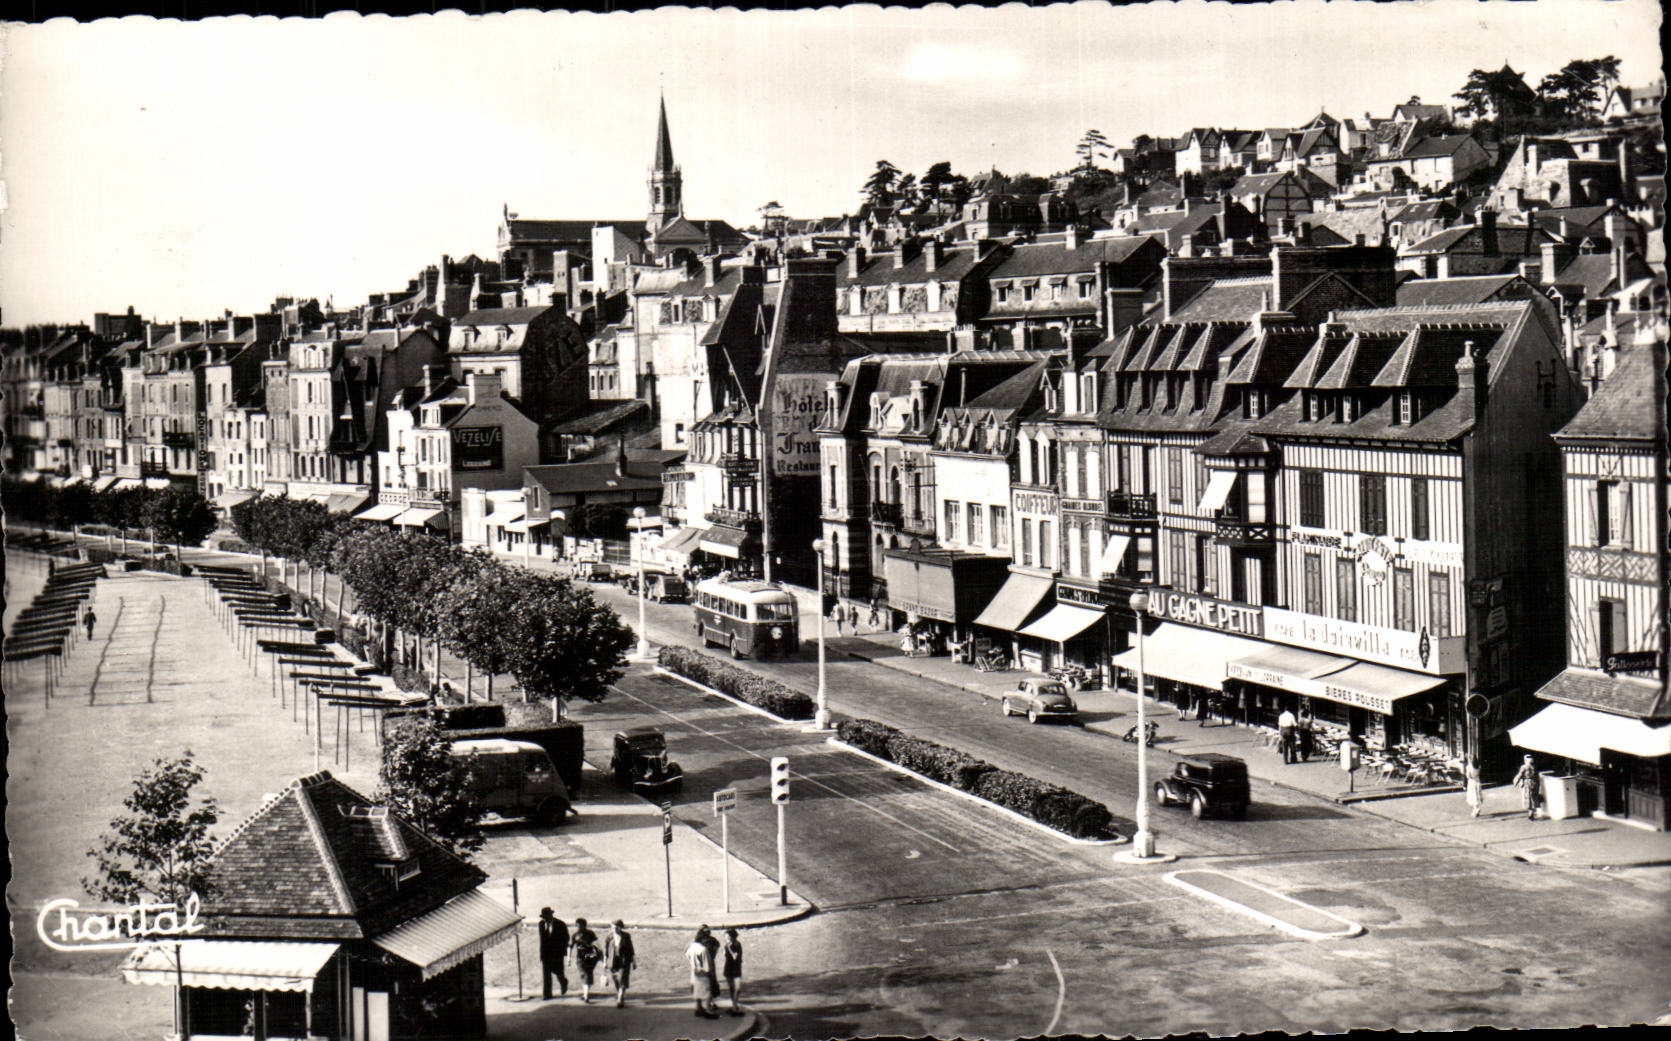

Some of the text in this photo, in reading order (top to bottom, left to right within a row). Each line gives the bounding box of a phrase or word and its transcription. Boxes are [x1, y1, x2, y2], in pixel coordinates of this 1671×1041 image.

[1015, 493, 1058, 516] COIFFEUR
[1147, 589, 1262, 635] AU GAGNE PETIT
[1325, 685, 1390, 711] BIERES POUSSET
